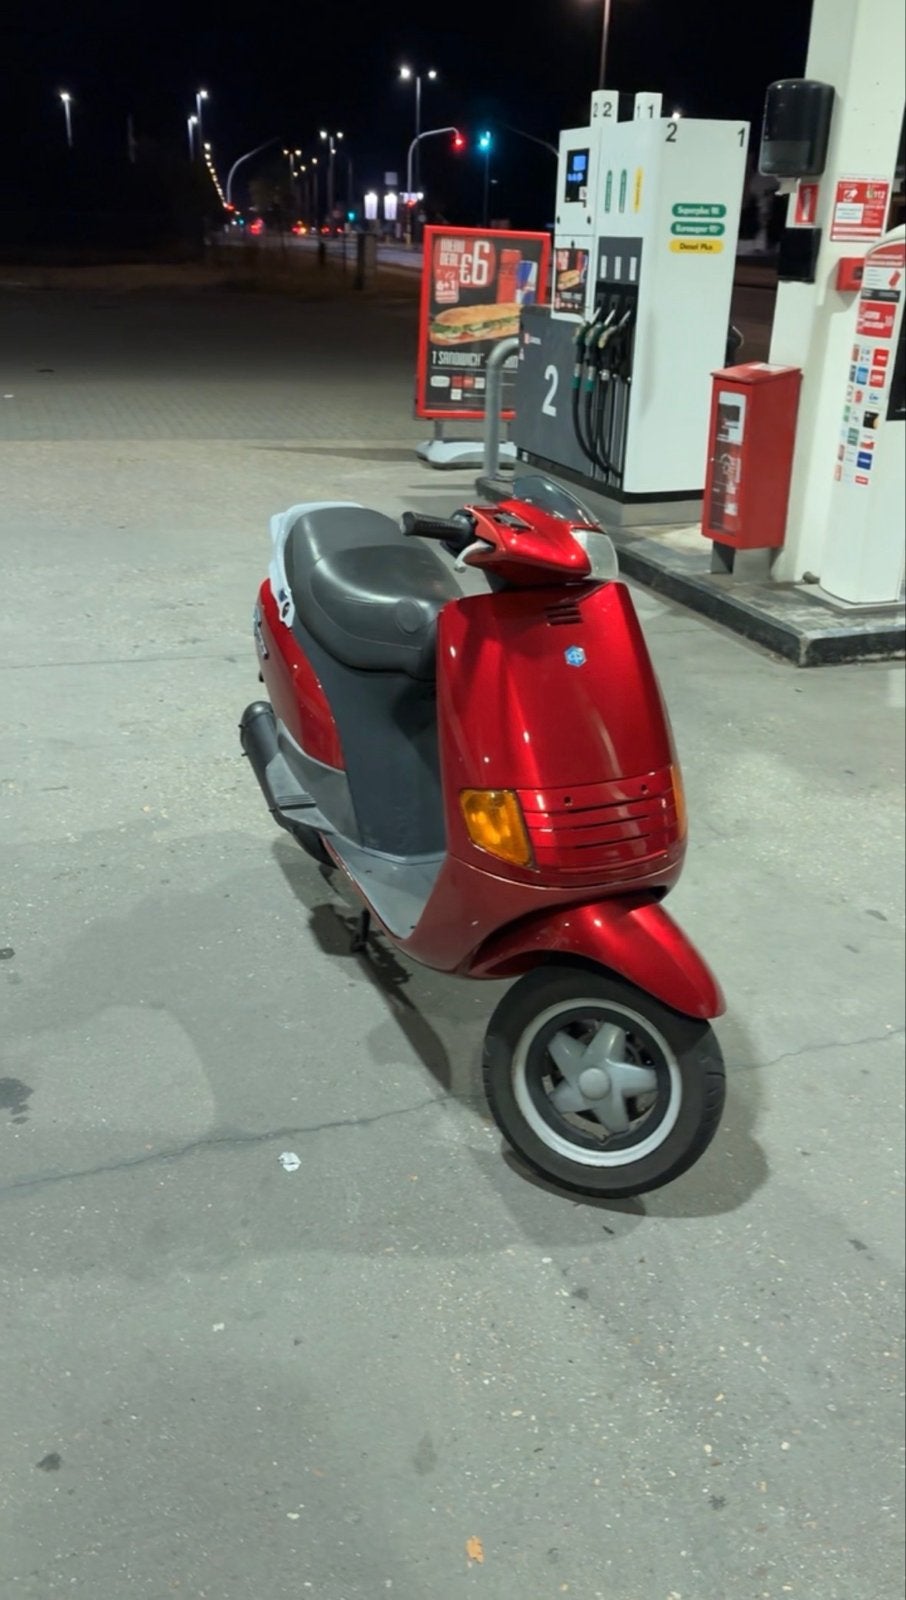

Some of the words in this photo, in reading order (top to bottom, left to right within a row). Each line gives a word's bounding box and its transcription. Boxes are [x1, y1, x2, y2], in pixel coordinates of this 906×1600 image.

[602, 101, 613, 118] 2
[647, 104, 655, 119] 1
[665, 122, 678, 143] 2
[736, 127, 746, 148] 1
[541, 364, 559, 417] 2
